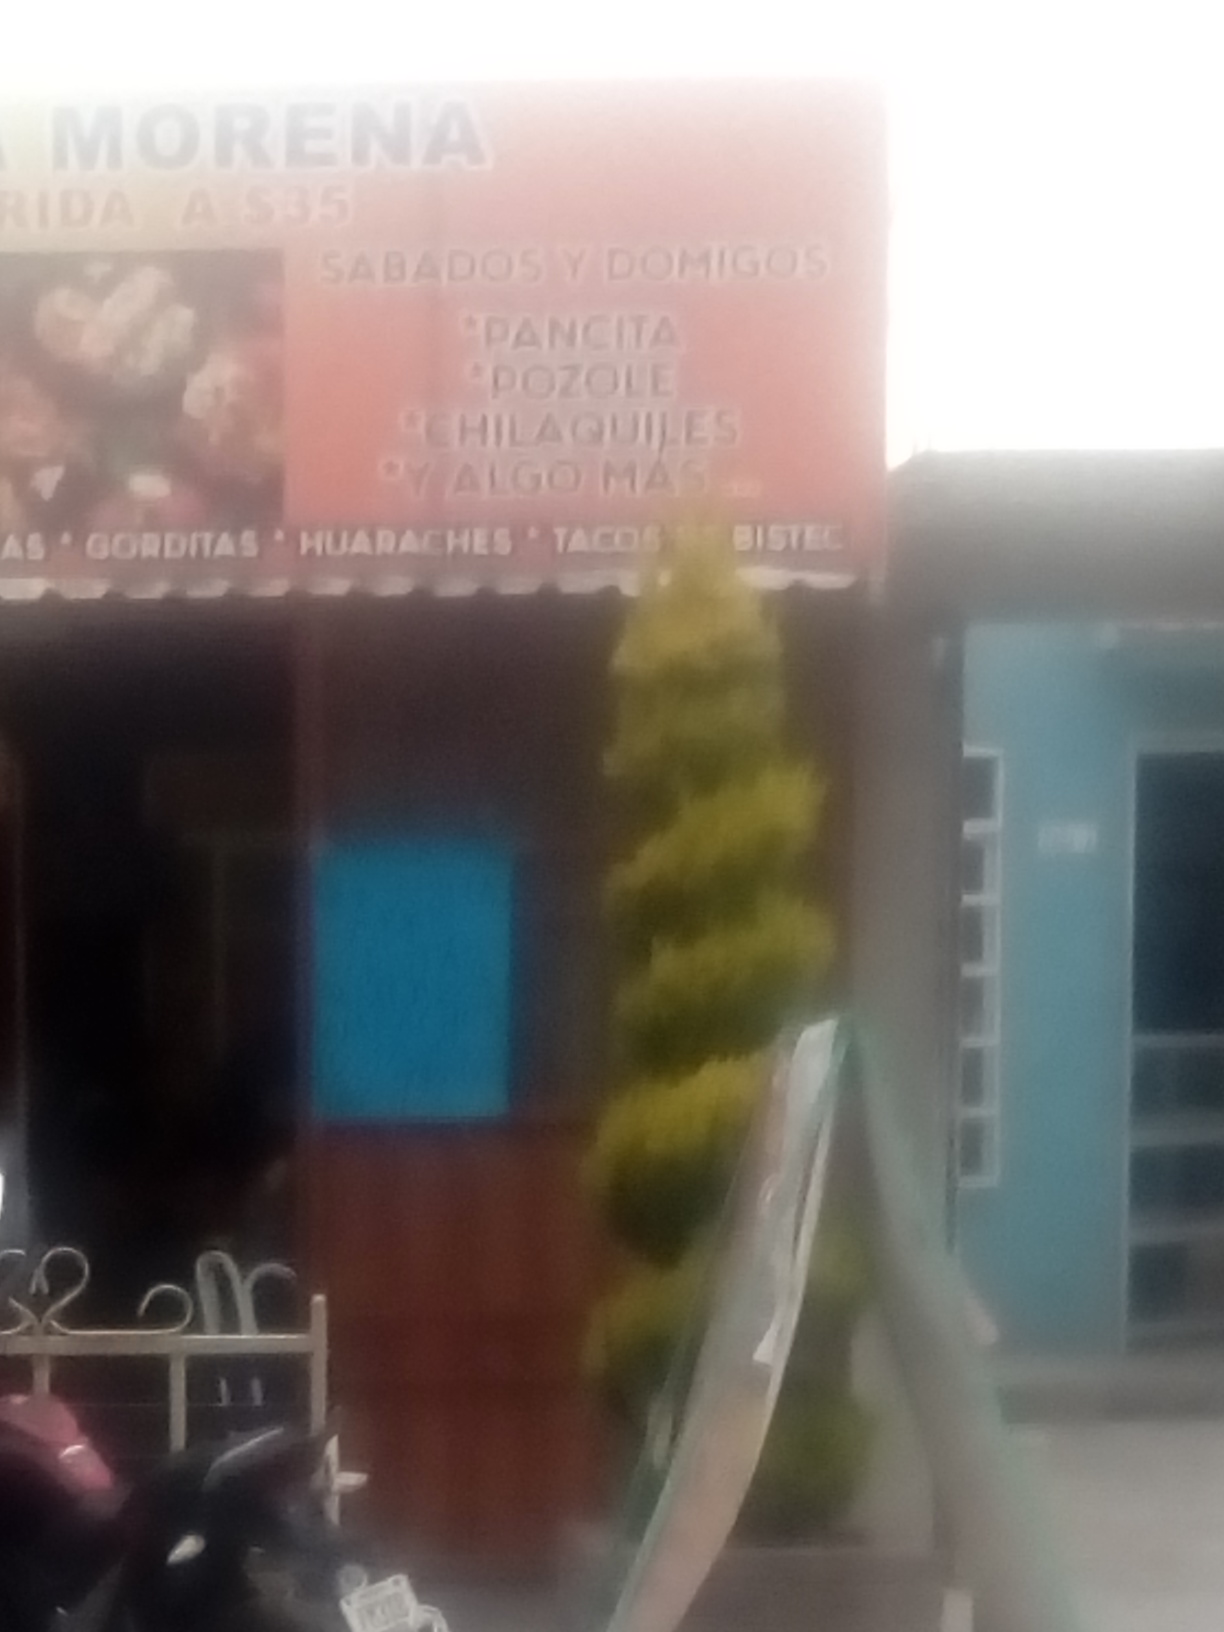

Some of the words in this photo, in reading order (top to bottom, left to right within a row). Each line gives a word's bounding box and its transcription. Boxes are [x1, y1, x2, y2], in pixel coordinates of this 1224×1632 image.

[51, 100, 487, 172] MORENA
[182, 187, 217, 226] A
[321, 249, 543, 285] SABADOS
[566, 248, 588, 281] Y
[608, 245, 827, 281] DOMIGOS
[453, 459, 582, 494] ALGO
[86, 530, 259, 561] GORDITAS
[300, 527, 512, 556] HUARACHES
[553, 526, 661, 553] TACOS
[733, 523, 844, 551] BISTEC
